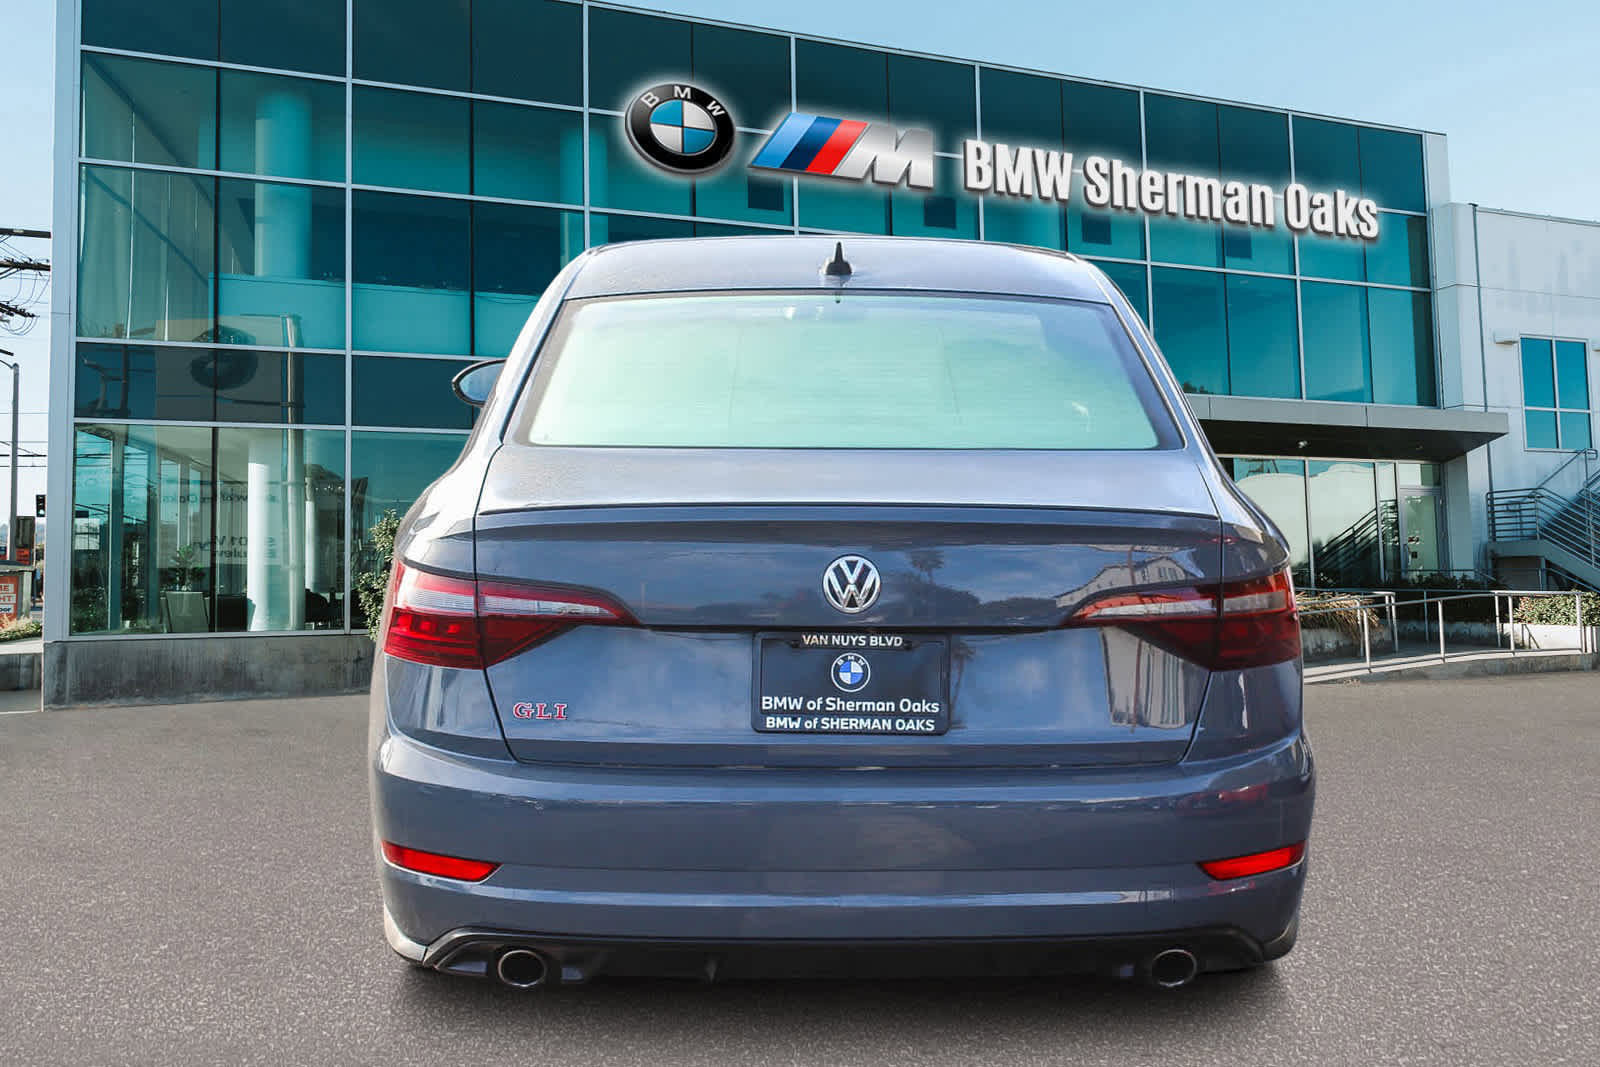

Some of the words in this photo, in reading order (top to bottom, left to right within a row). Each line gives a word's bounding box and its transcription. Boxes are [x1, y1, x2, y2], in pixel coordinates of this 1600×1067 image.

[640, 85, 726, 117] BMW
[963, 138, 1074, 204] BMW
[1082, 156, 1276, 228] Sherman
[1282, 182, 1380, 241] Oaks
[802, 635, 828, 645] VAN
[832, 635, 866, 646] NUYS
[869, 636, 903, 647] BLVD
[513, 702, 568, 720] GLI
[761, 696, 803, 710] BMW
[806, 697, 822, 711] of
[825, 697, 896, 712] Sherman
[899, 698, 940, 713] Oaks
[765, 717, 802, 729] BMW
[804, 717, 818, 729] of
[820, 717, 892, 731] SHERMAN
[895, 719, 935, 731] OAKS
